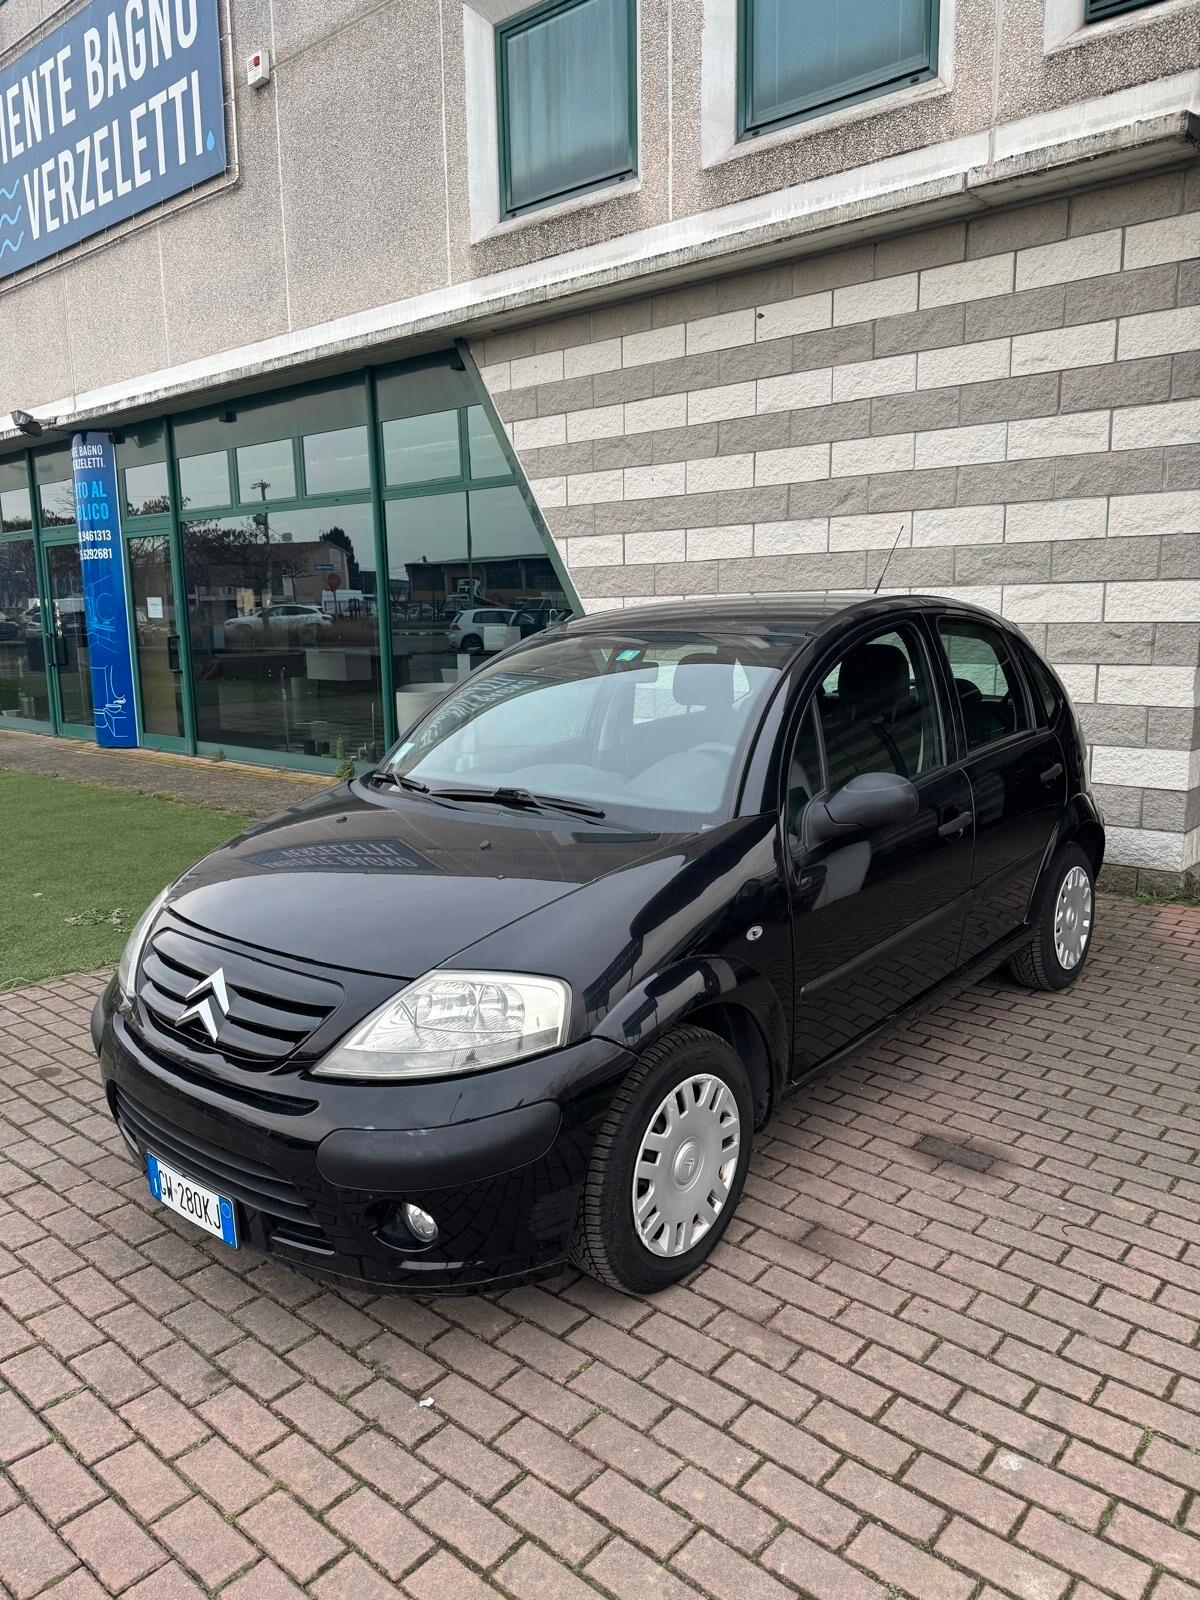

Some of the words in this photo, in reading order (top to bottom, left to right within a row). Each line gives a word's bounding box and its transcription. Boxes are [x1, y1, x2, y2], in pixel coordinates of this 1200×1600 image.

[84, 0, 198, 110] BAGNO
[79, 444, 103, 457] BAGNO
[91, 480, 107, 498] AL
